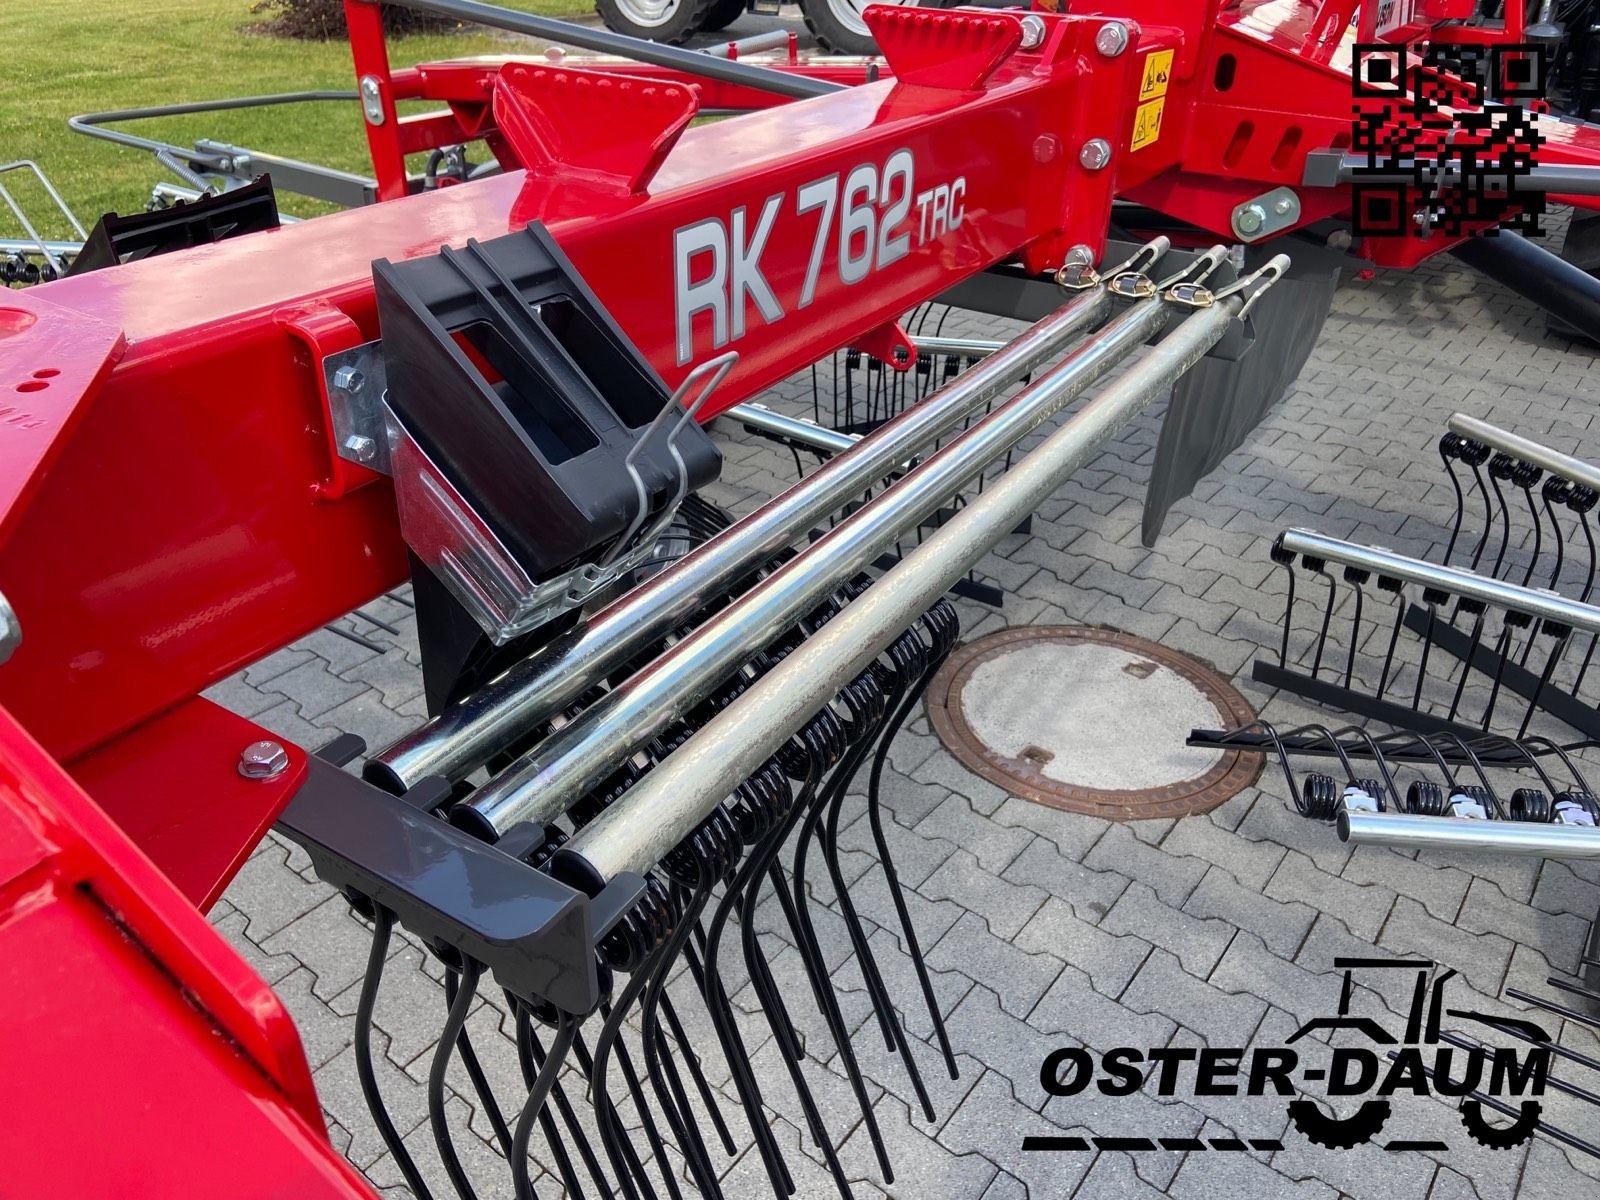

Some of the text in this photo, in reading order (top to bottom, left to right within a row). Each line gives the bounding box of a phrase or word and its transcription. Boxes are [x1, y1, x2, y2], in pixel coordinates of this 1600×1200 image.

[673, 147, 966, 367] RK 762 TRC
